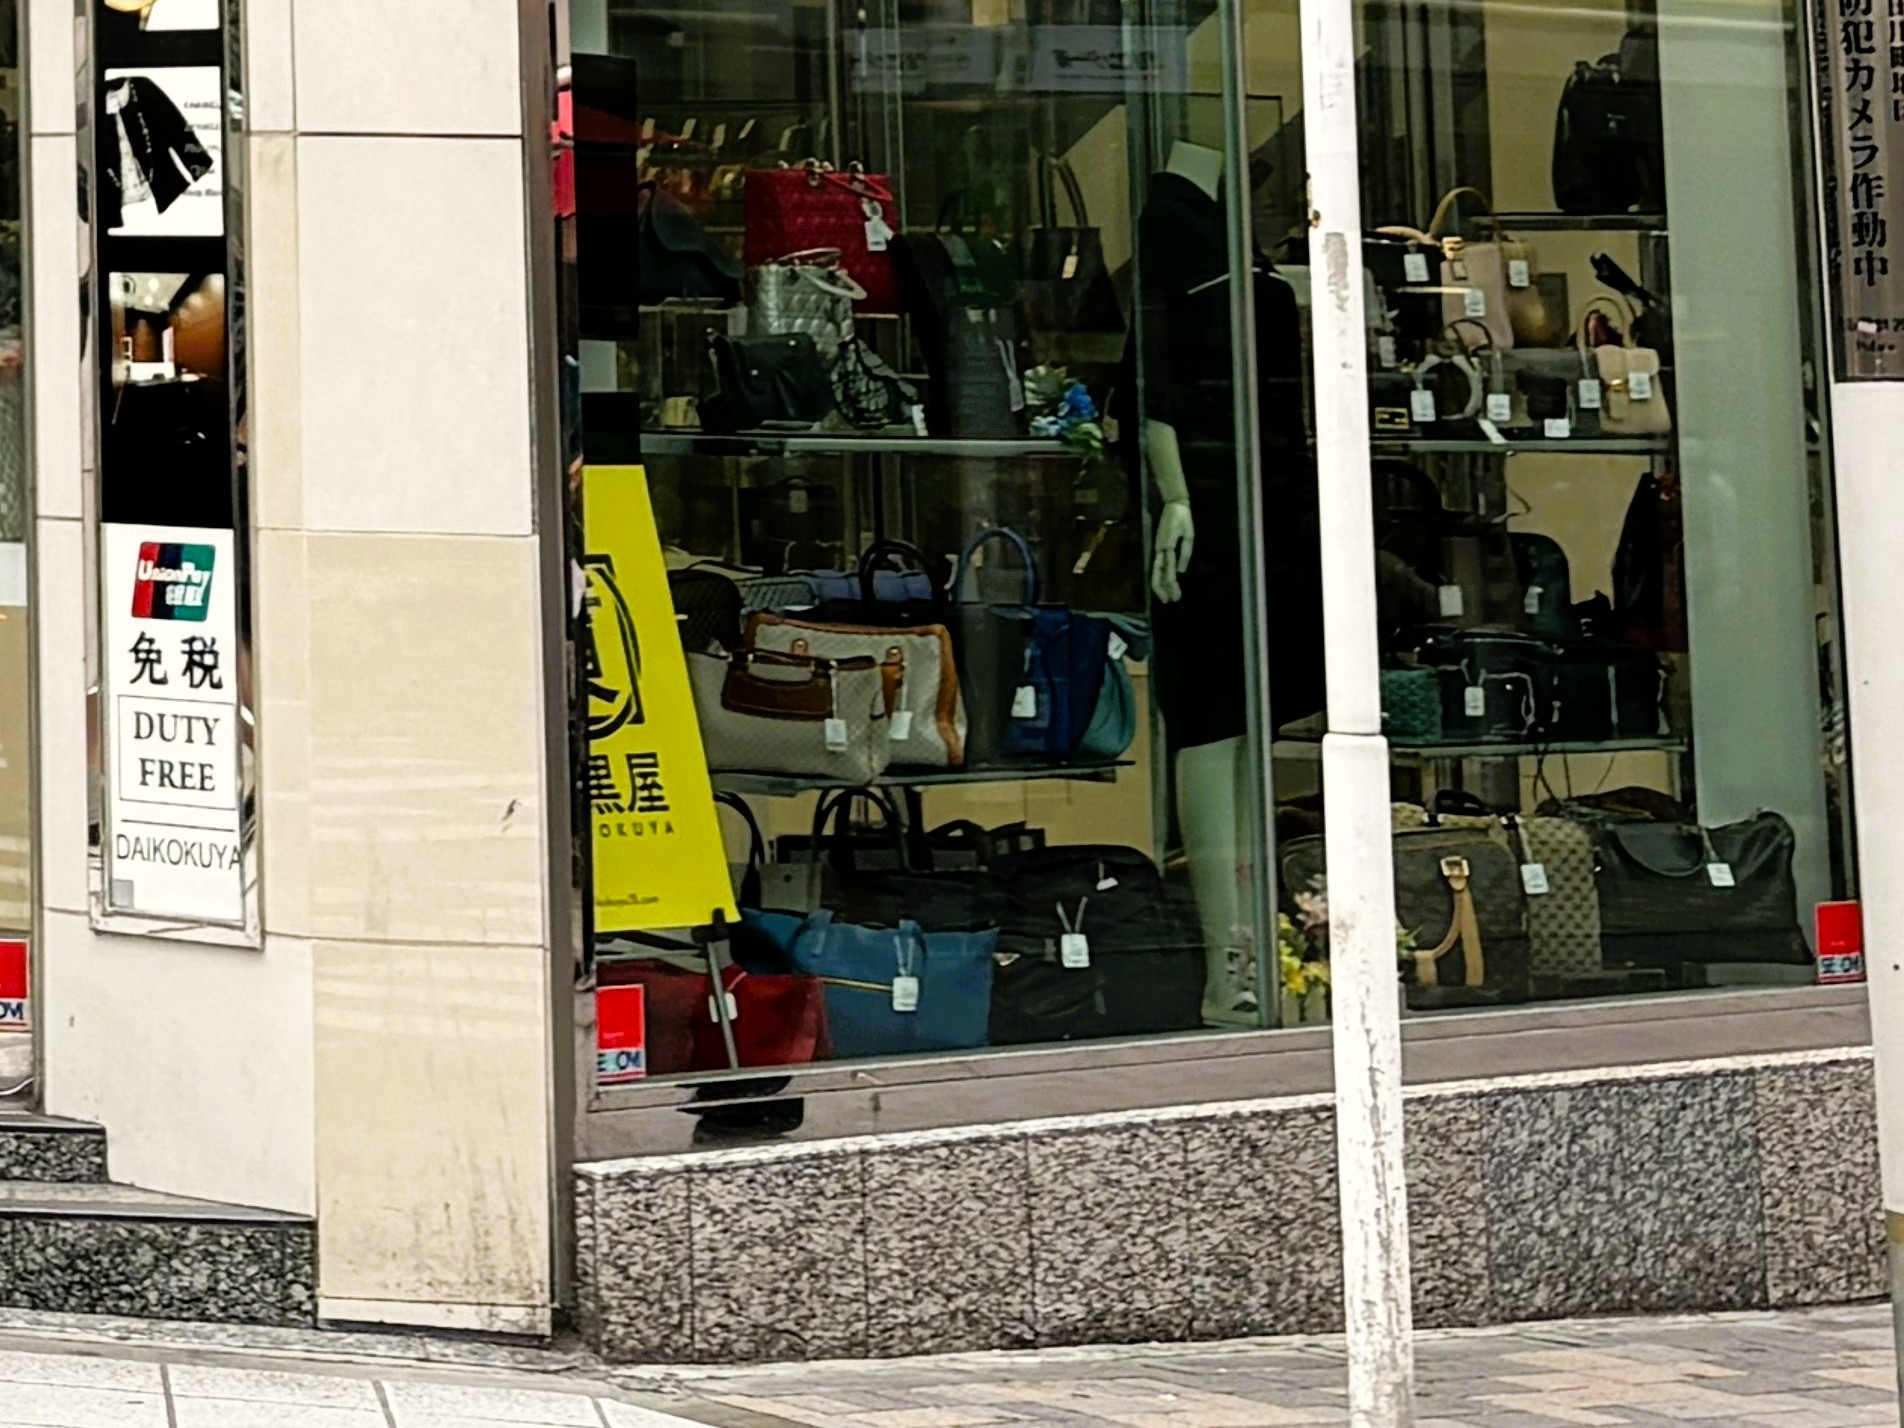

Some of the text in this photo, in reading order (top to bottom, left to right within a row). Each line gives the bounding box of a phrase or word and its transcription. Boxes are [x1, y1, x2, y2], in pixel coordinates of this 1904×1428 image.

[137, 559, 212, 593] UnionPay
[128, 630, 224, 690] 免税
[133, 712, 221, 747] DUTY
[139, 757, 216, 793] FREE
[115, 831, 242, 872] DAIKOKUYA
